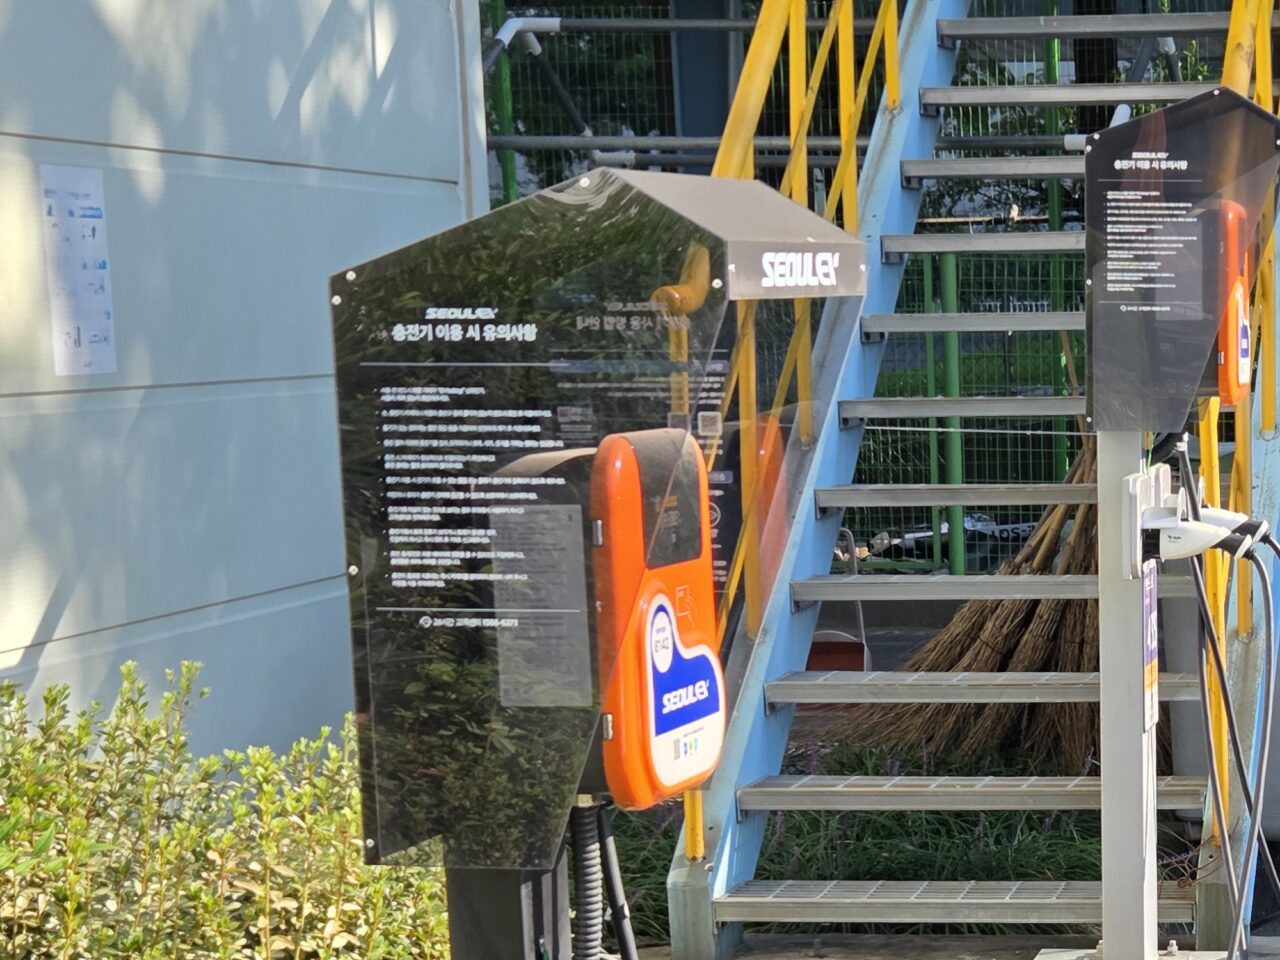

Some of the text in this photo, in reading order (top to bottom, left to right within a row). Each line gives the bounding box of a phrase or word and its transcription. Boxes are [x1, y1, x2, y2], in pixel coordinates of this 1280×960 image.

[391, 323, 538, 341] 충전기 이용 시 유의사항
